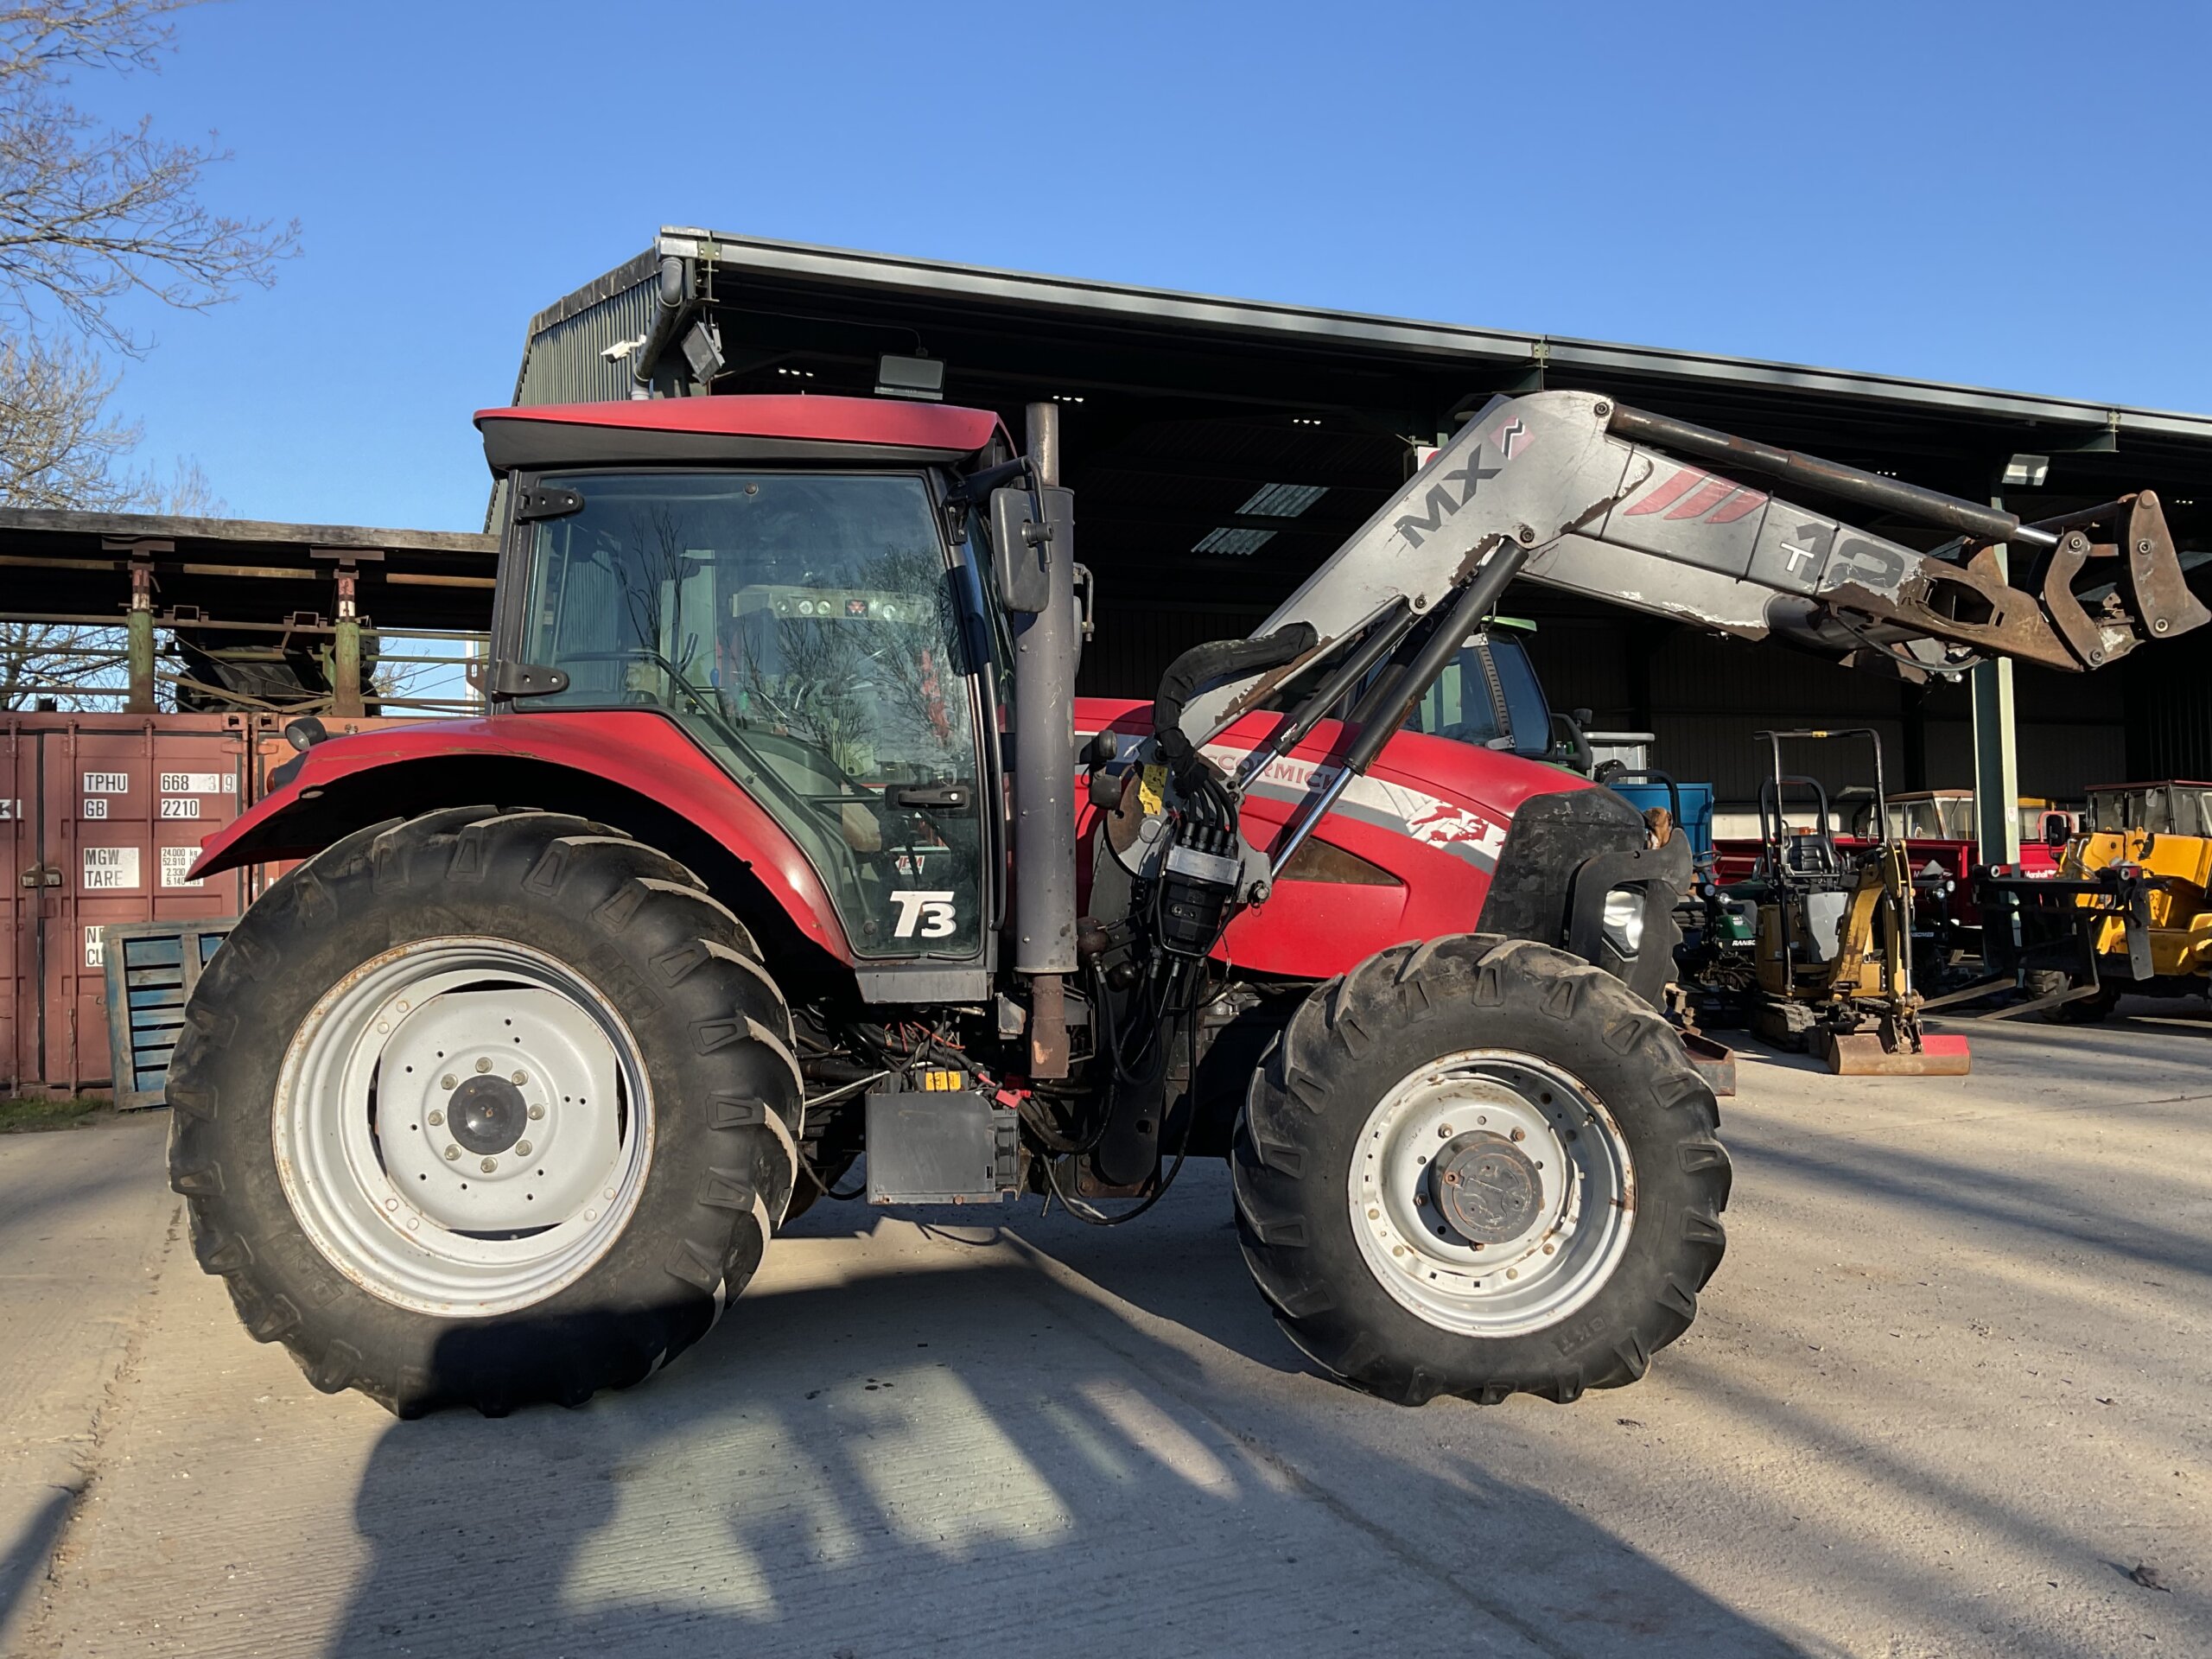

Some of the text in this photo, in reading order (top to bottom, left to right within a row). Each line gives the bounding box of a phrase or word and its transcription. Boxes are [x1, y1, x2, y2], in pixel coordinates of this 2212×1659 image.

[1393, 442, 1503, 550] MX
[86, 774, 126, 791] TPHU
[86, 800, 198, 817] GB 2210
[85, 849, 119, 866] MGW
[86, 870, 123, 887] TARE
[889, 890, 957, 938] T3
